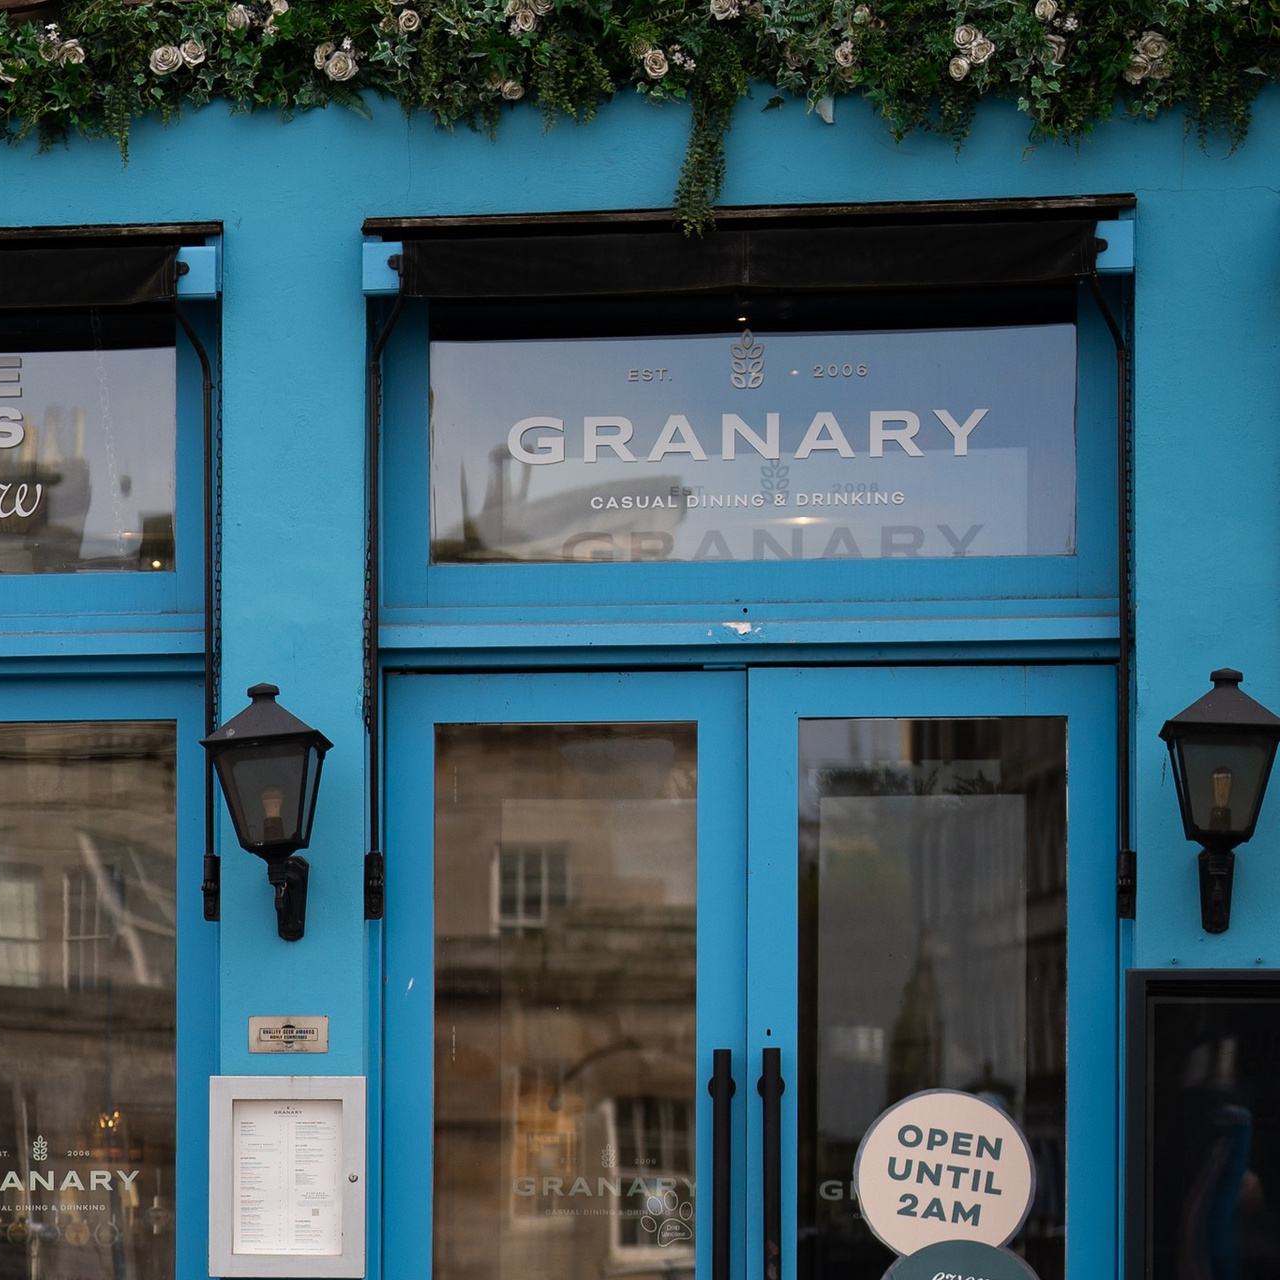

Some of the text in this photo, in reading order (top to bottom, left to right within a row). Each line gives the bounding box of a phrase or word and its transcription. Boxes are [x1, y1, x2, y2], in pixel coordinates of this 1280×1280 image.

[627, 367, 674, 382] EST.
[812, 363, 869, 378] 2006
[506, 407, 990, 465] GRANARY
[589, 490, 906, 511] CASUAL DINING & DRINKING
[67, 1149, 91, 1157] 2006
[896, 1123, 1003, 1162] OPEN
[511, 1176, 697, 1198] GRANARY
[887, 1156, 1003, 1197] UNTIL
[15, 1204, 48, 1212] DINING
[896, 1193, 982, 1227] 2AM
